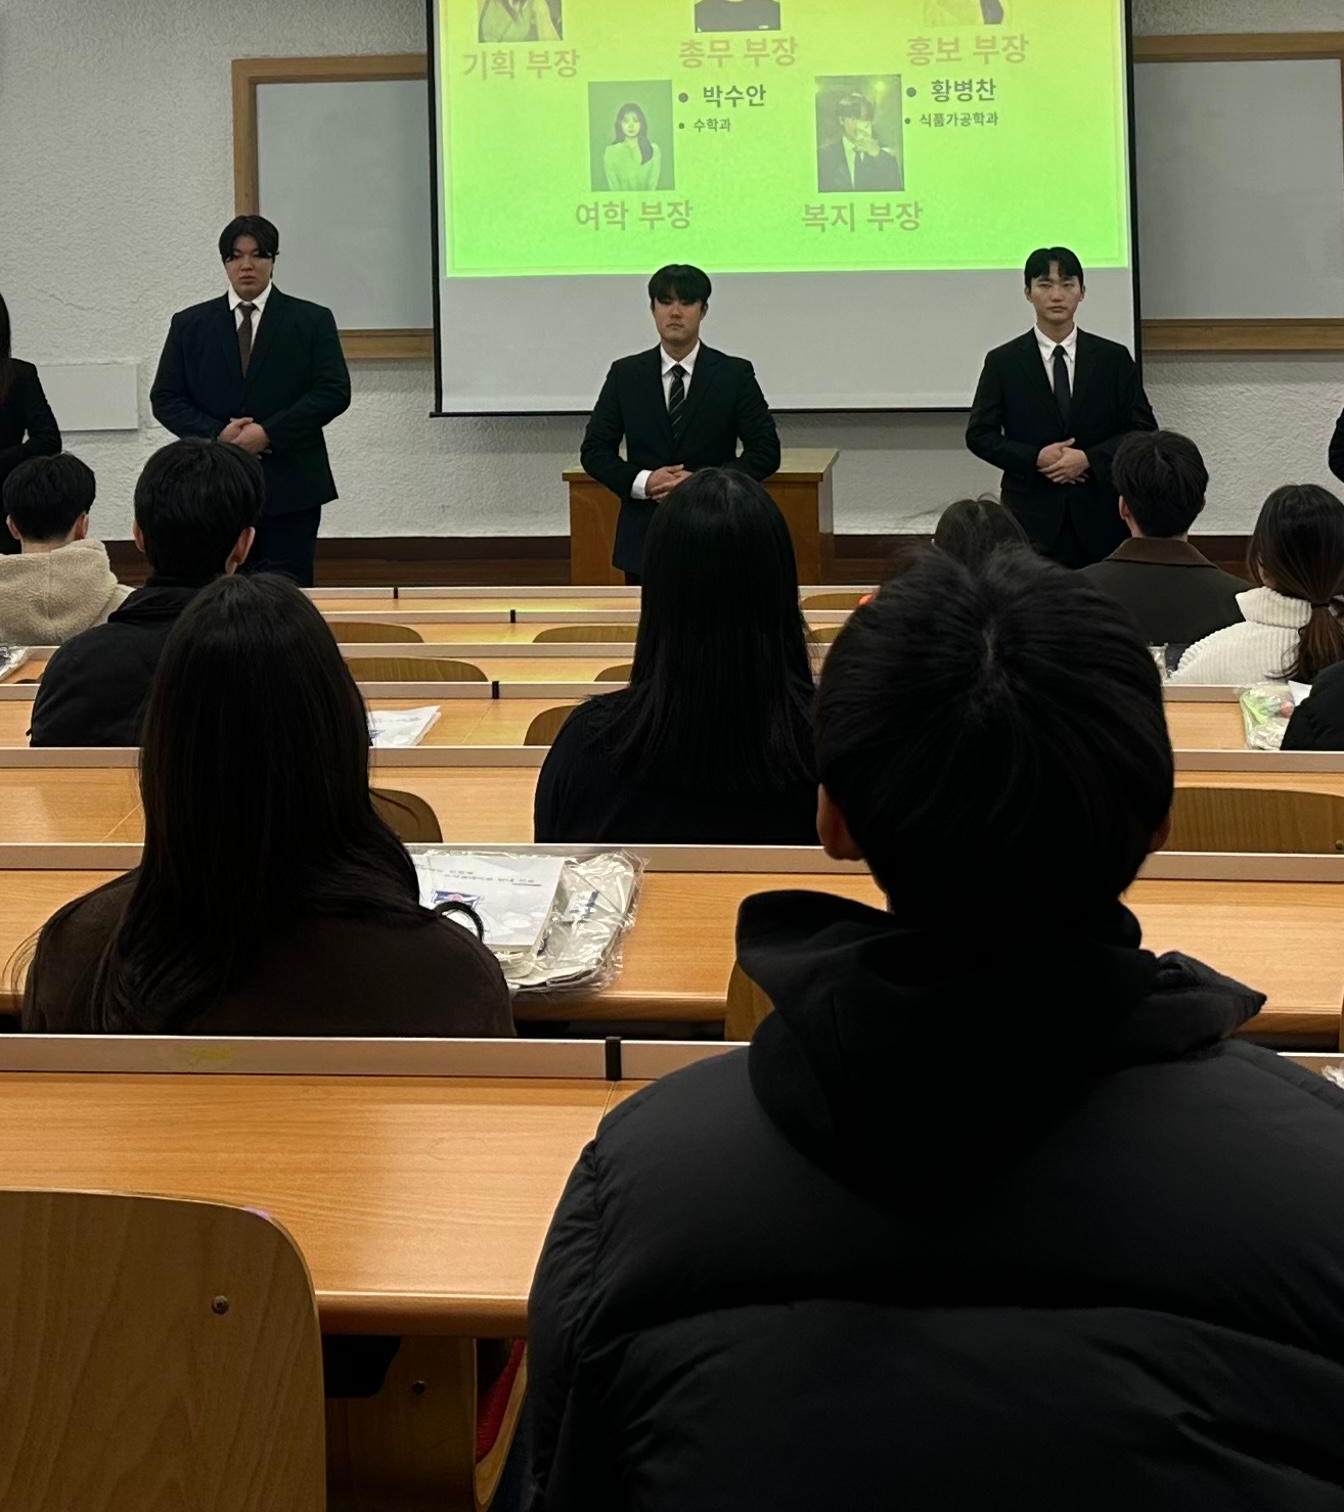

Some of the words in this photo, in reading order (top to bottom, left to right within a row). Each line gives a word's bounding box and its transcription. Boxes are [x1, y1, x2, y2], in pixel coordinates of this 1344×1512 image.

[463, 49, 515, 80] 기획
[526, 49, 580, 79] 부장
[679, 39, 734, 69] 총무
[744, 36, 798, 67] 부장
[907, 36, 962, 66] 홍보
[973, 33, 1029, 65] 부장
[703, 84, 767, 108] 박수안
[931, 79, 996, 103] 황병찬
[694, 118, 731, 132] 수학과
[919, 111, 998, 127] 식품가공학과
[576, 200, 629, 232] 여학
[639, 199, 693, 230] 부장
[801, 202, 855, 233] 복지
[867, 200, 923, 232] 부장
